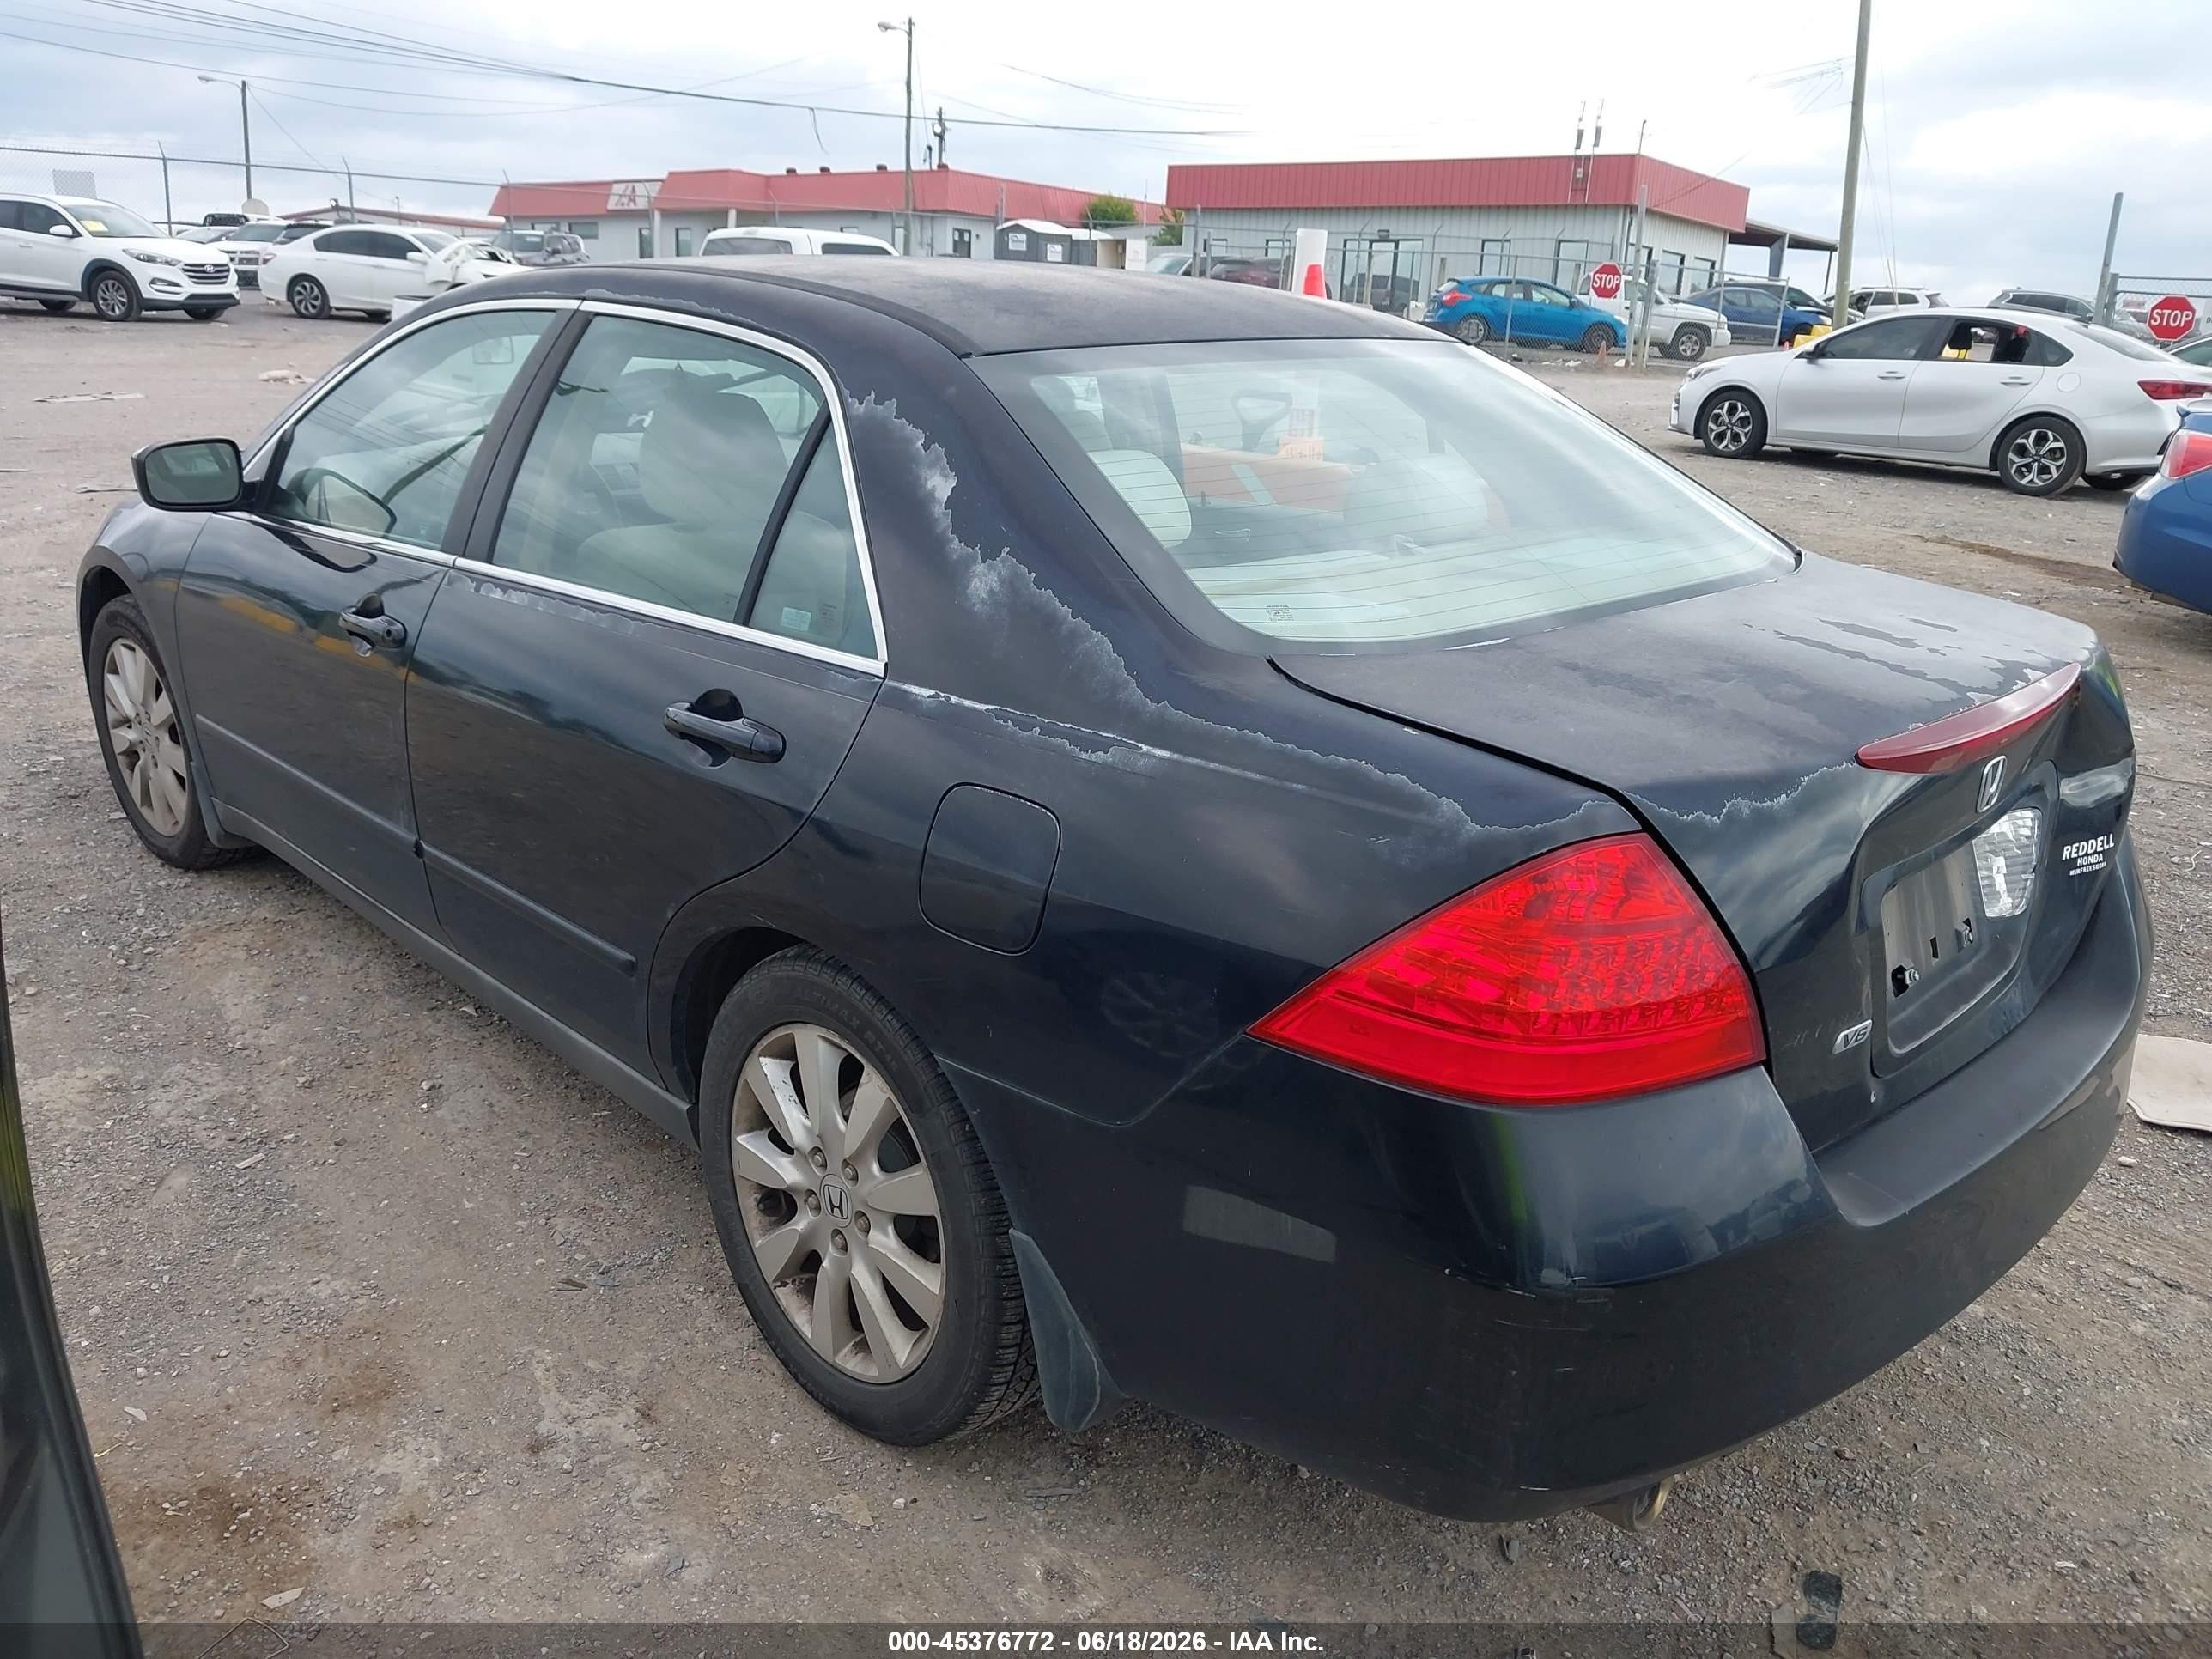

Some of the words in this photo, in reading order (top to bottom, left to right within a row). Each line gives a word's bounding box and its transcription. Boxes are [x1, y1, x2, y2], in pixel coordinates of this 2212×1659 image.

[1594, 273, 1620, 289] STOP
[2150, 308, 2193, 327] STOP
[2062, 833, 2115, 860] REDDELL
[2076, 854, 2103, 866] HONDA
[1843, 1026, 1869, 1048] V6
